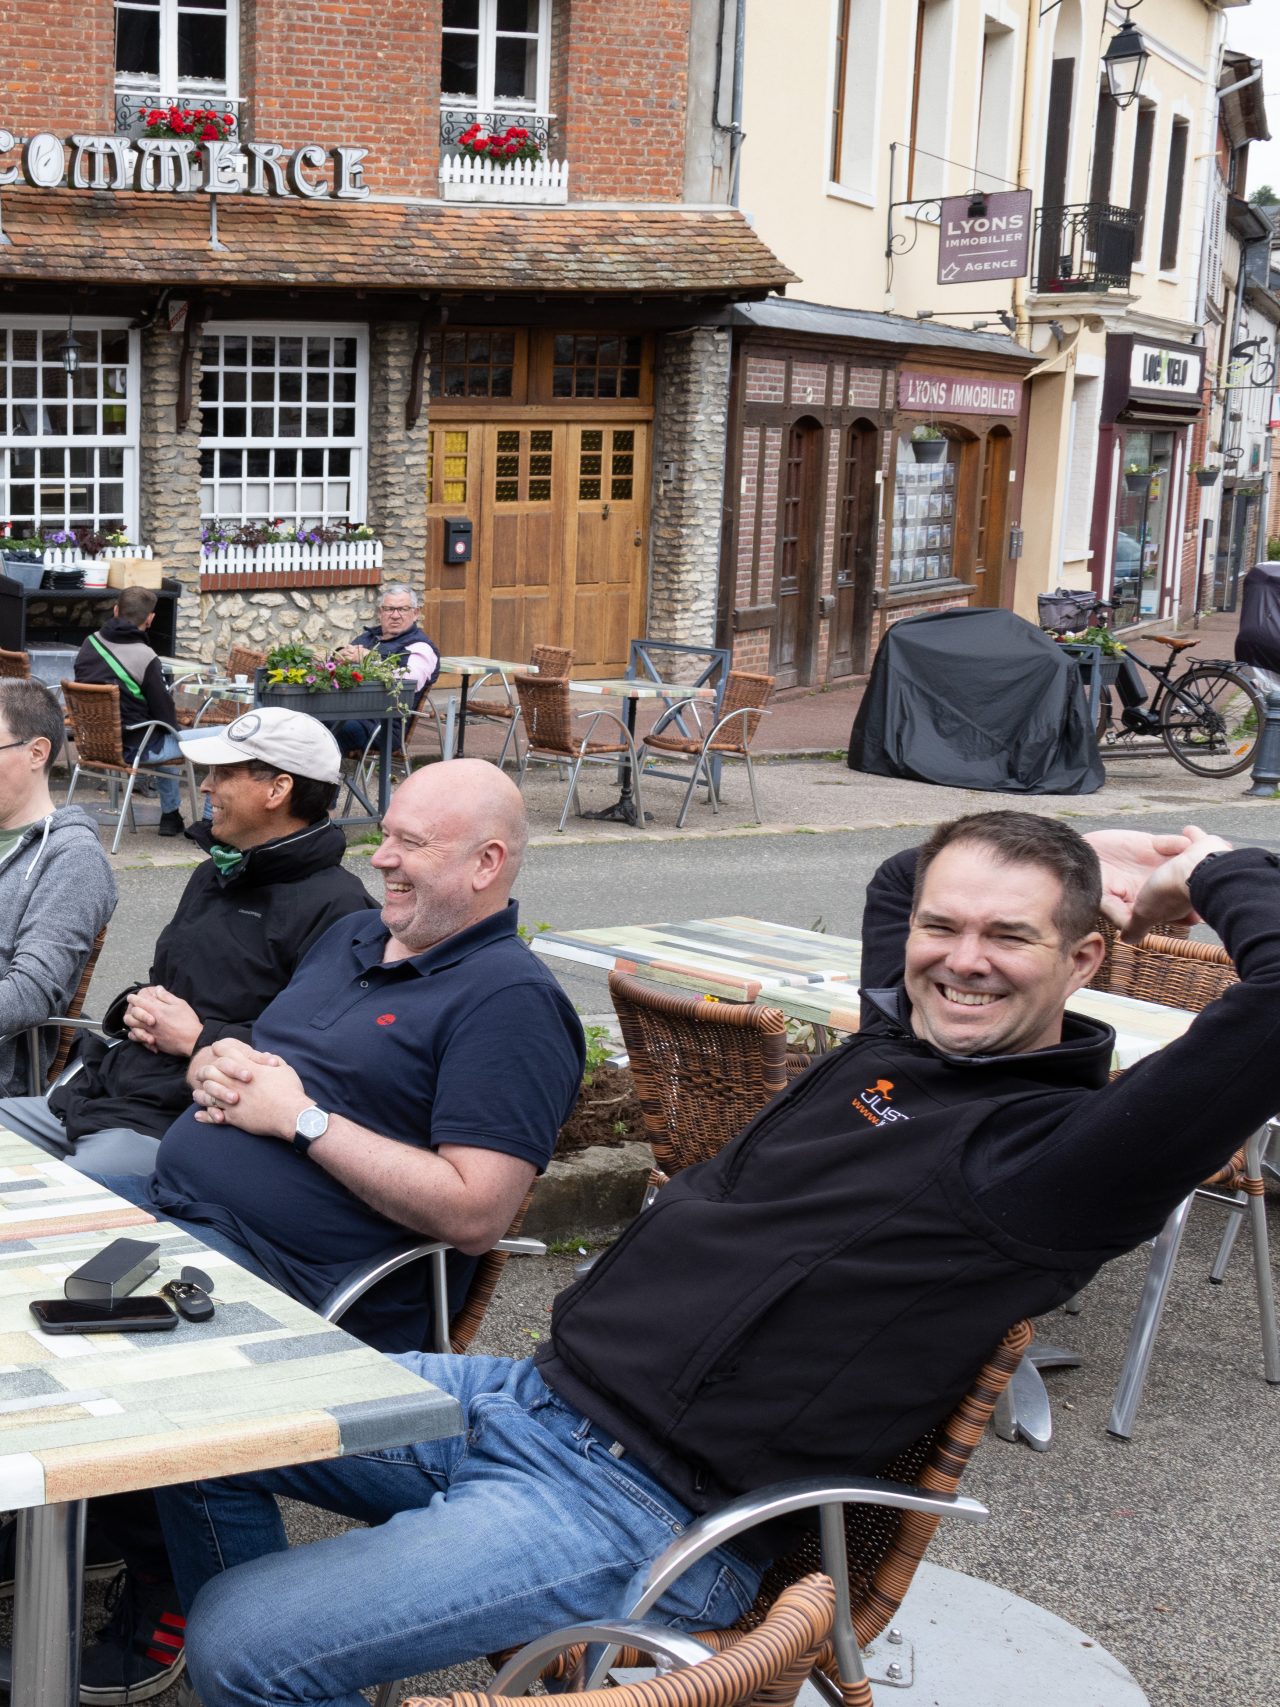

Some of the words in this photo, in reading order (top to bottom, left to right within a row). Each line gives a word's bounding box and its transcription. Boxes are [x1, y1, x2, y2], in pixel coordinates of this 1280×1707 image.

[947, 214, 1024, 236] LYONS
[945, 233, 1023, 248] IMMOBILIER
[964, 259, 1018, 272] AGENCE
[908, 380, 947, 405] LYONS
[950, 384, 1016, 410] IMMOBILIER
